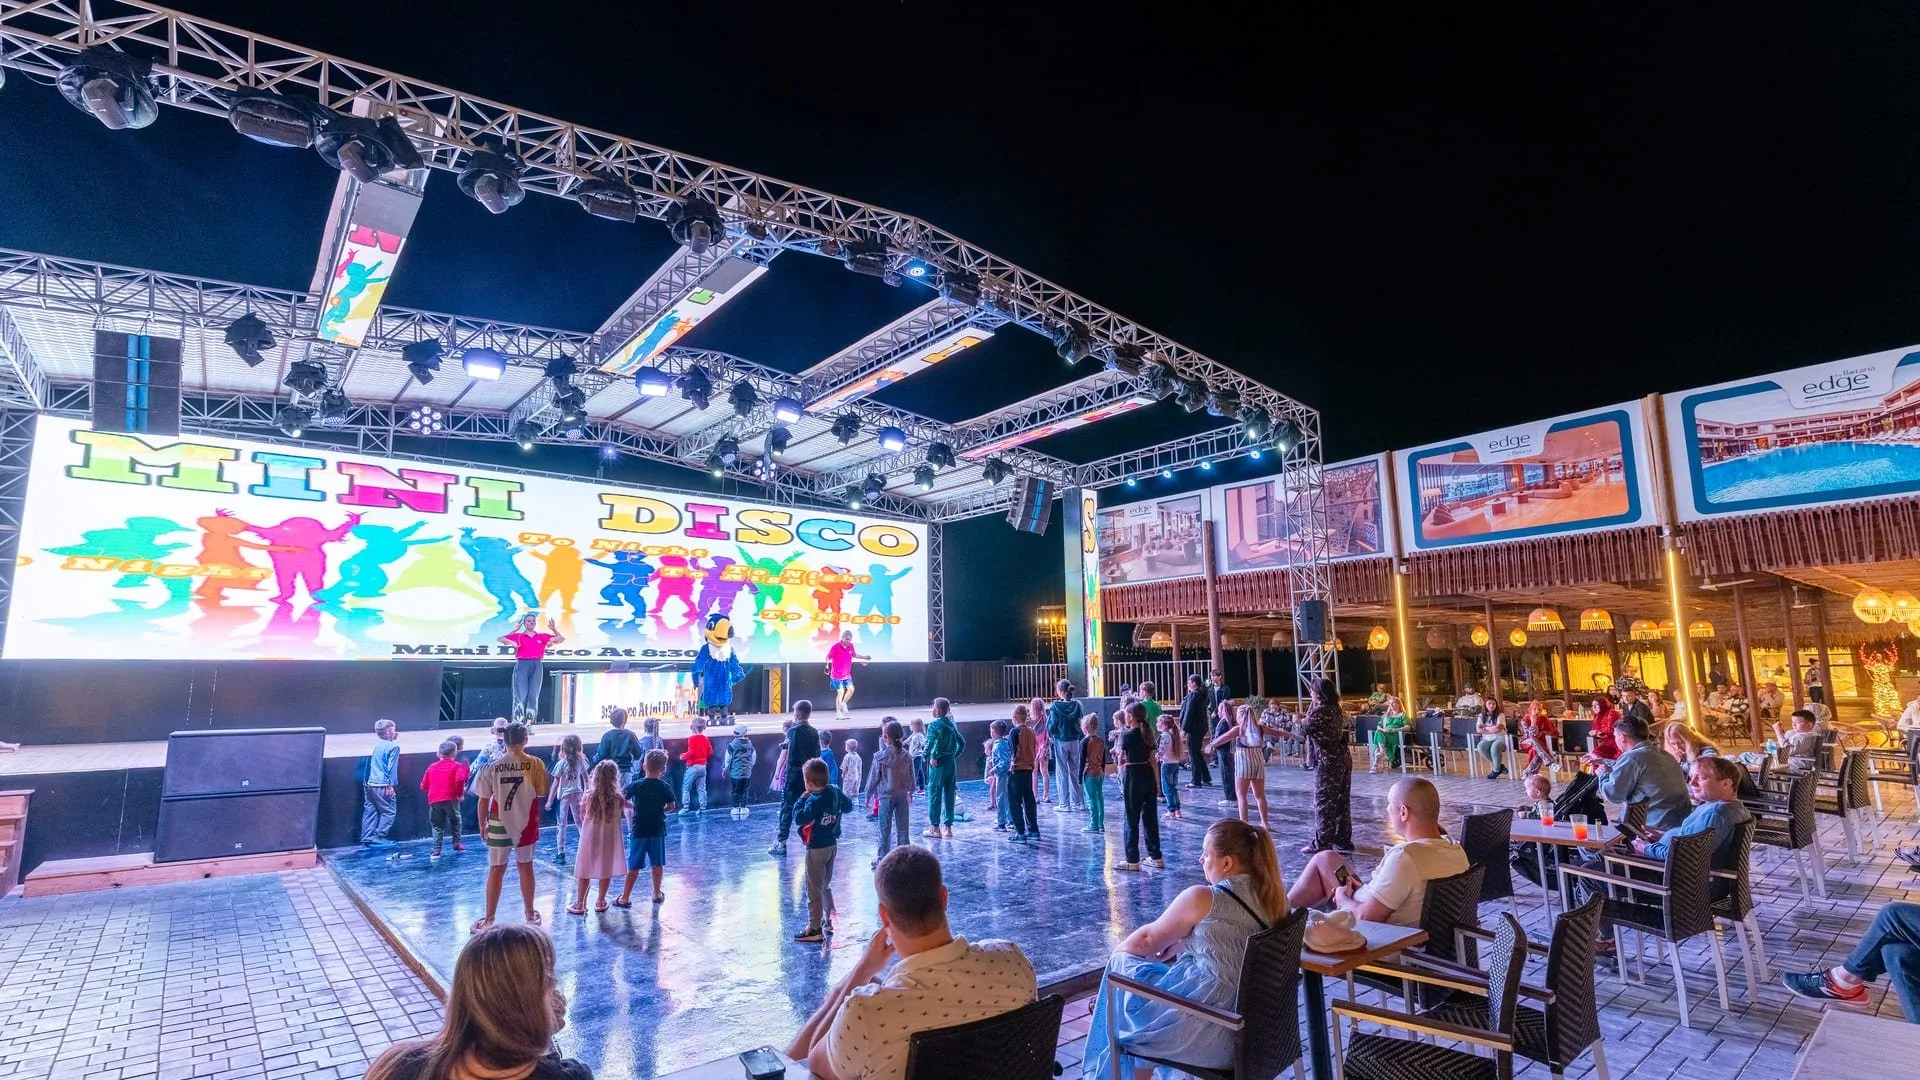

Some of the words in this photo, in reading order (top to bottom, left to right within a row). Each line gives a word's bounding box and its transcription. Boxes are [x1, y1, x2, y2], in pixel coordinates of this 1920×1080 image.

[1803, 373, 1869, 395] edge
[1489, 434, 1530, 450] edge
[65, 428, 525, 520] MINI
[598, 493, 920, 558] DISCO
[392, 644, 490, 656] Mini
[497, 645, 592, 657] Dsco
[597, 647, 635, 657] At
[641, 649, 698, 657] 8:30
[495, 762, 531, 773] RONALDO
[500, 776, 524, 811] 7
